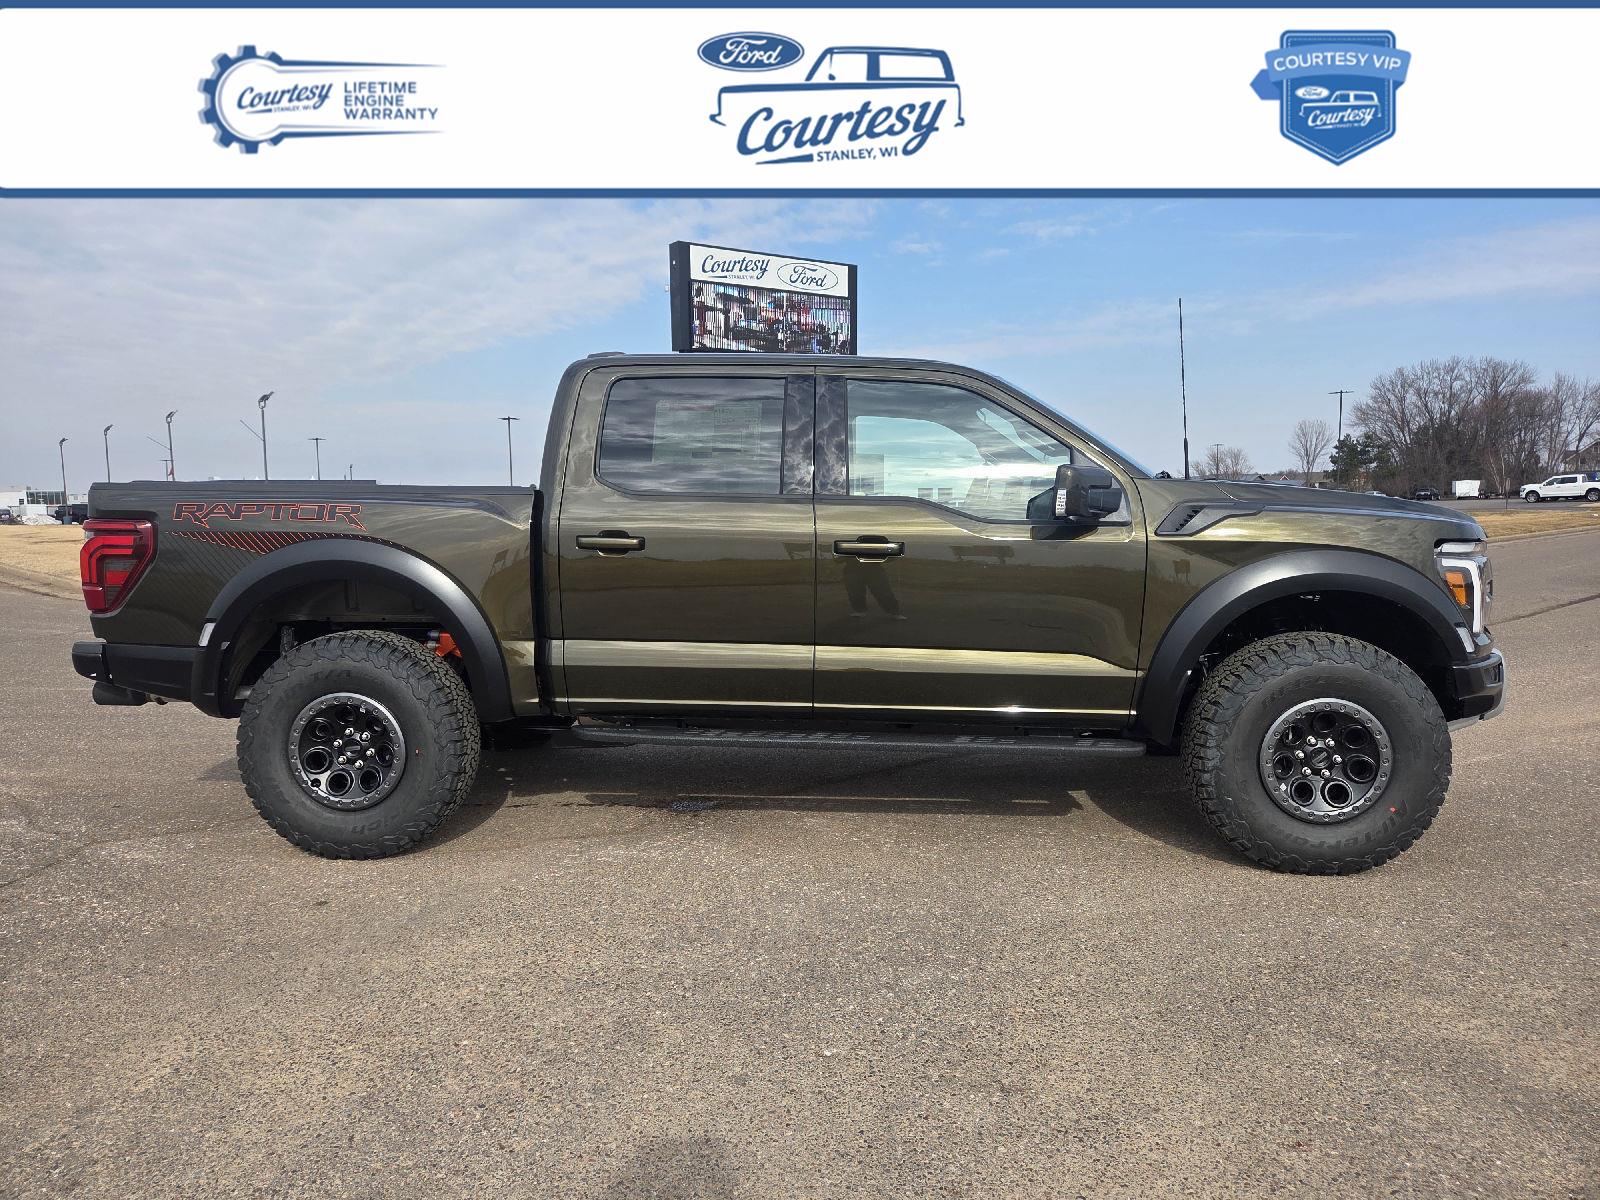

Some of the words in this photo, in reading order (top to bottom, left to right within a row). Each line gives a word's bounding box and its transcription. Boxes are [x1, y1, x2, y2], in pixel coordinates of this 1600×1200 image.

[701, 254, 771, 280] Courtesy
[789, 265, 828, 288] Ford
[172, 501, 368, 532] RAPTOR
